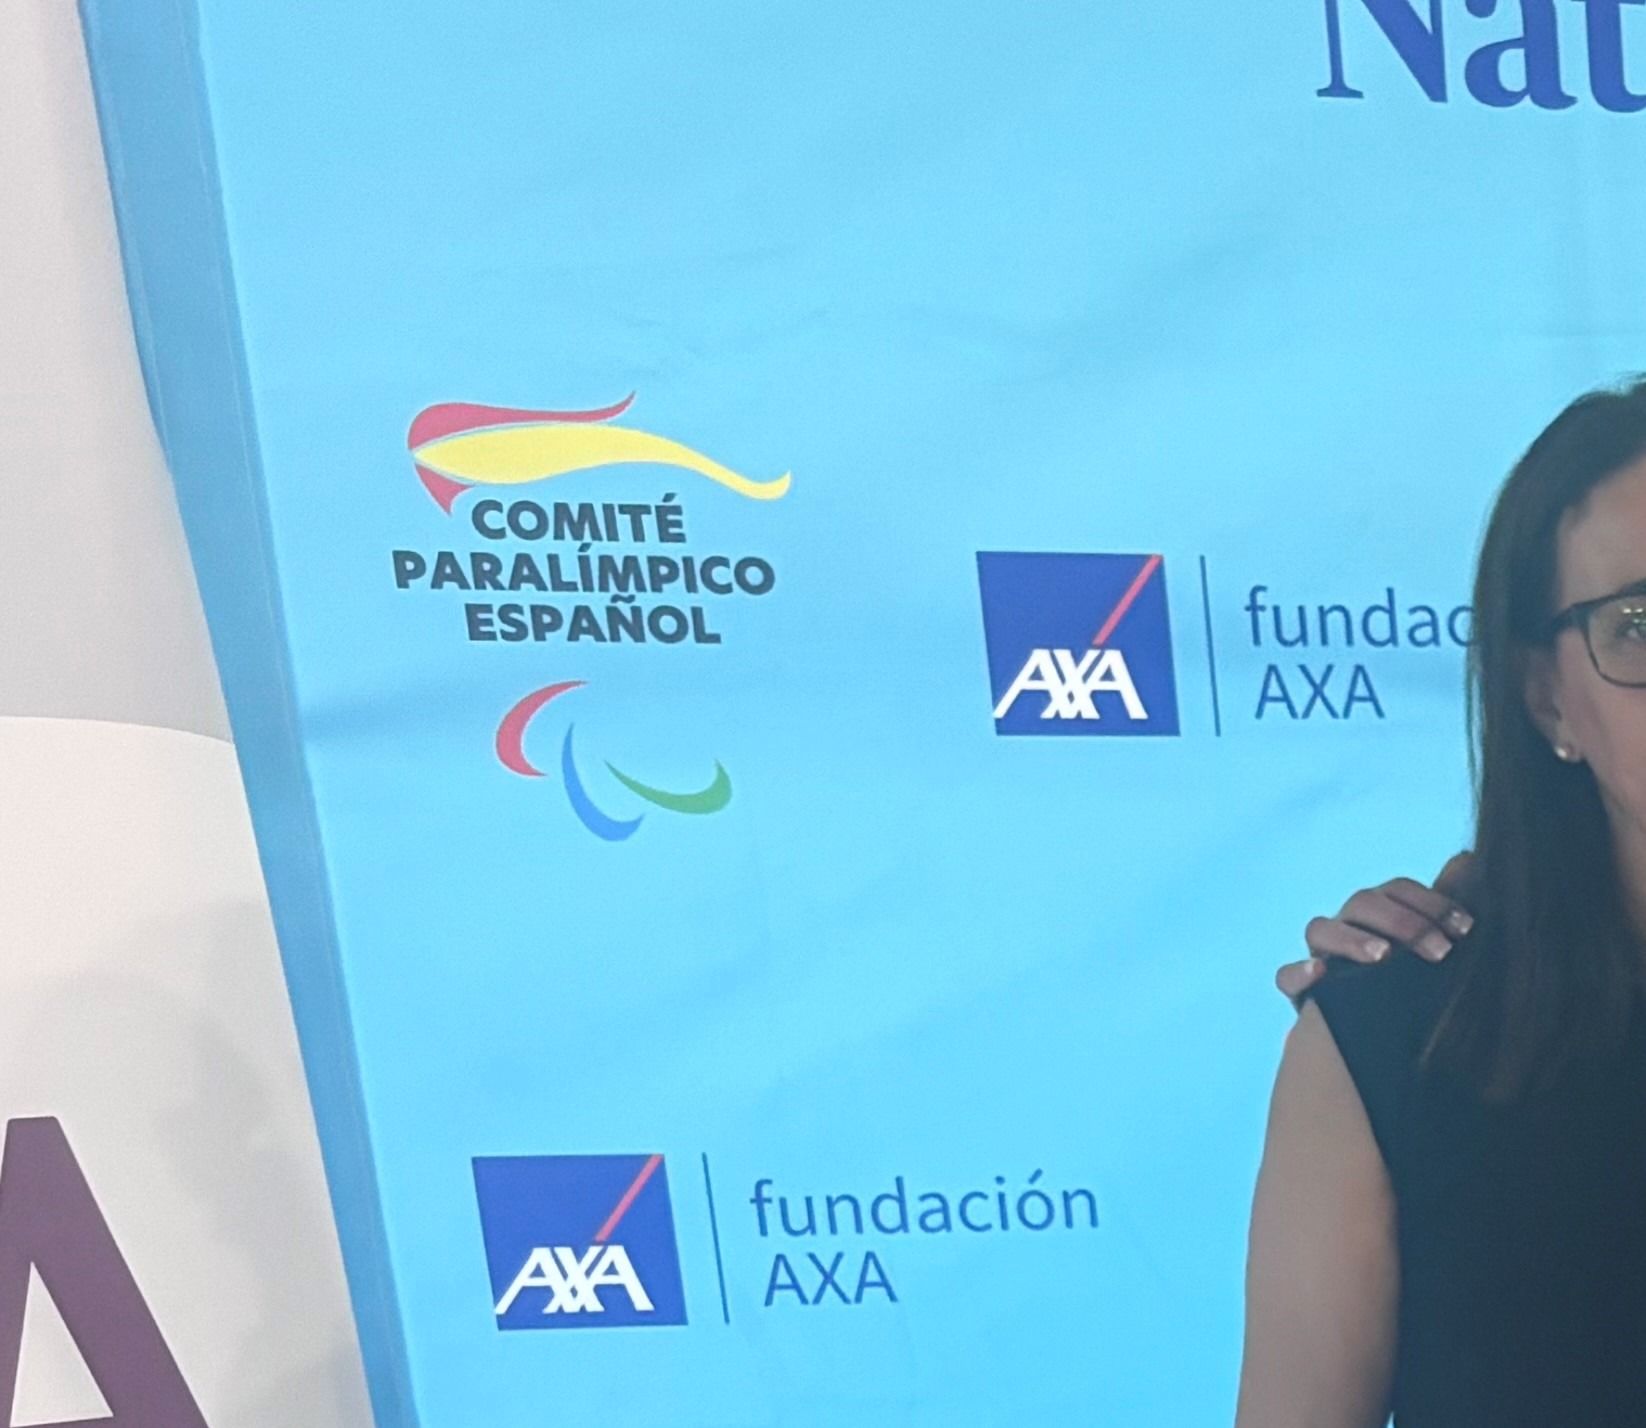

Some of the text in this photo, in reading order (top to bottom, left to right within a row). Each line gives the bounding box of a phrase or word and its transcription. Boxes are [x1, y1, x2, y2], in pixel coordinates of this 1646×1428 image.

[471, 493, 687, 544] COMITÉ
[392, 544, 776, 596] PARALÍMPICO
[465, 594, 722, 645] ESPAÑOL
[992, 648, 1149, 721] AXA
[1254, 663, 1386, 720] AXA
[748, 1167, 1100, 1238] fundación
[494, 1244, 656, 1315] AXA
[762, 1249, 900, 1307] AXA
